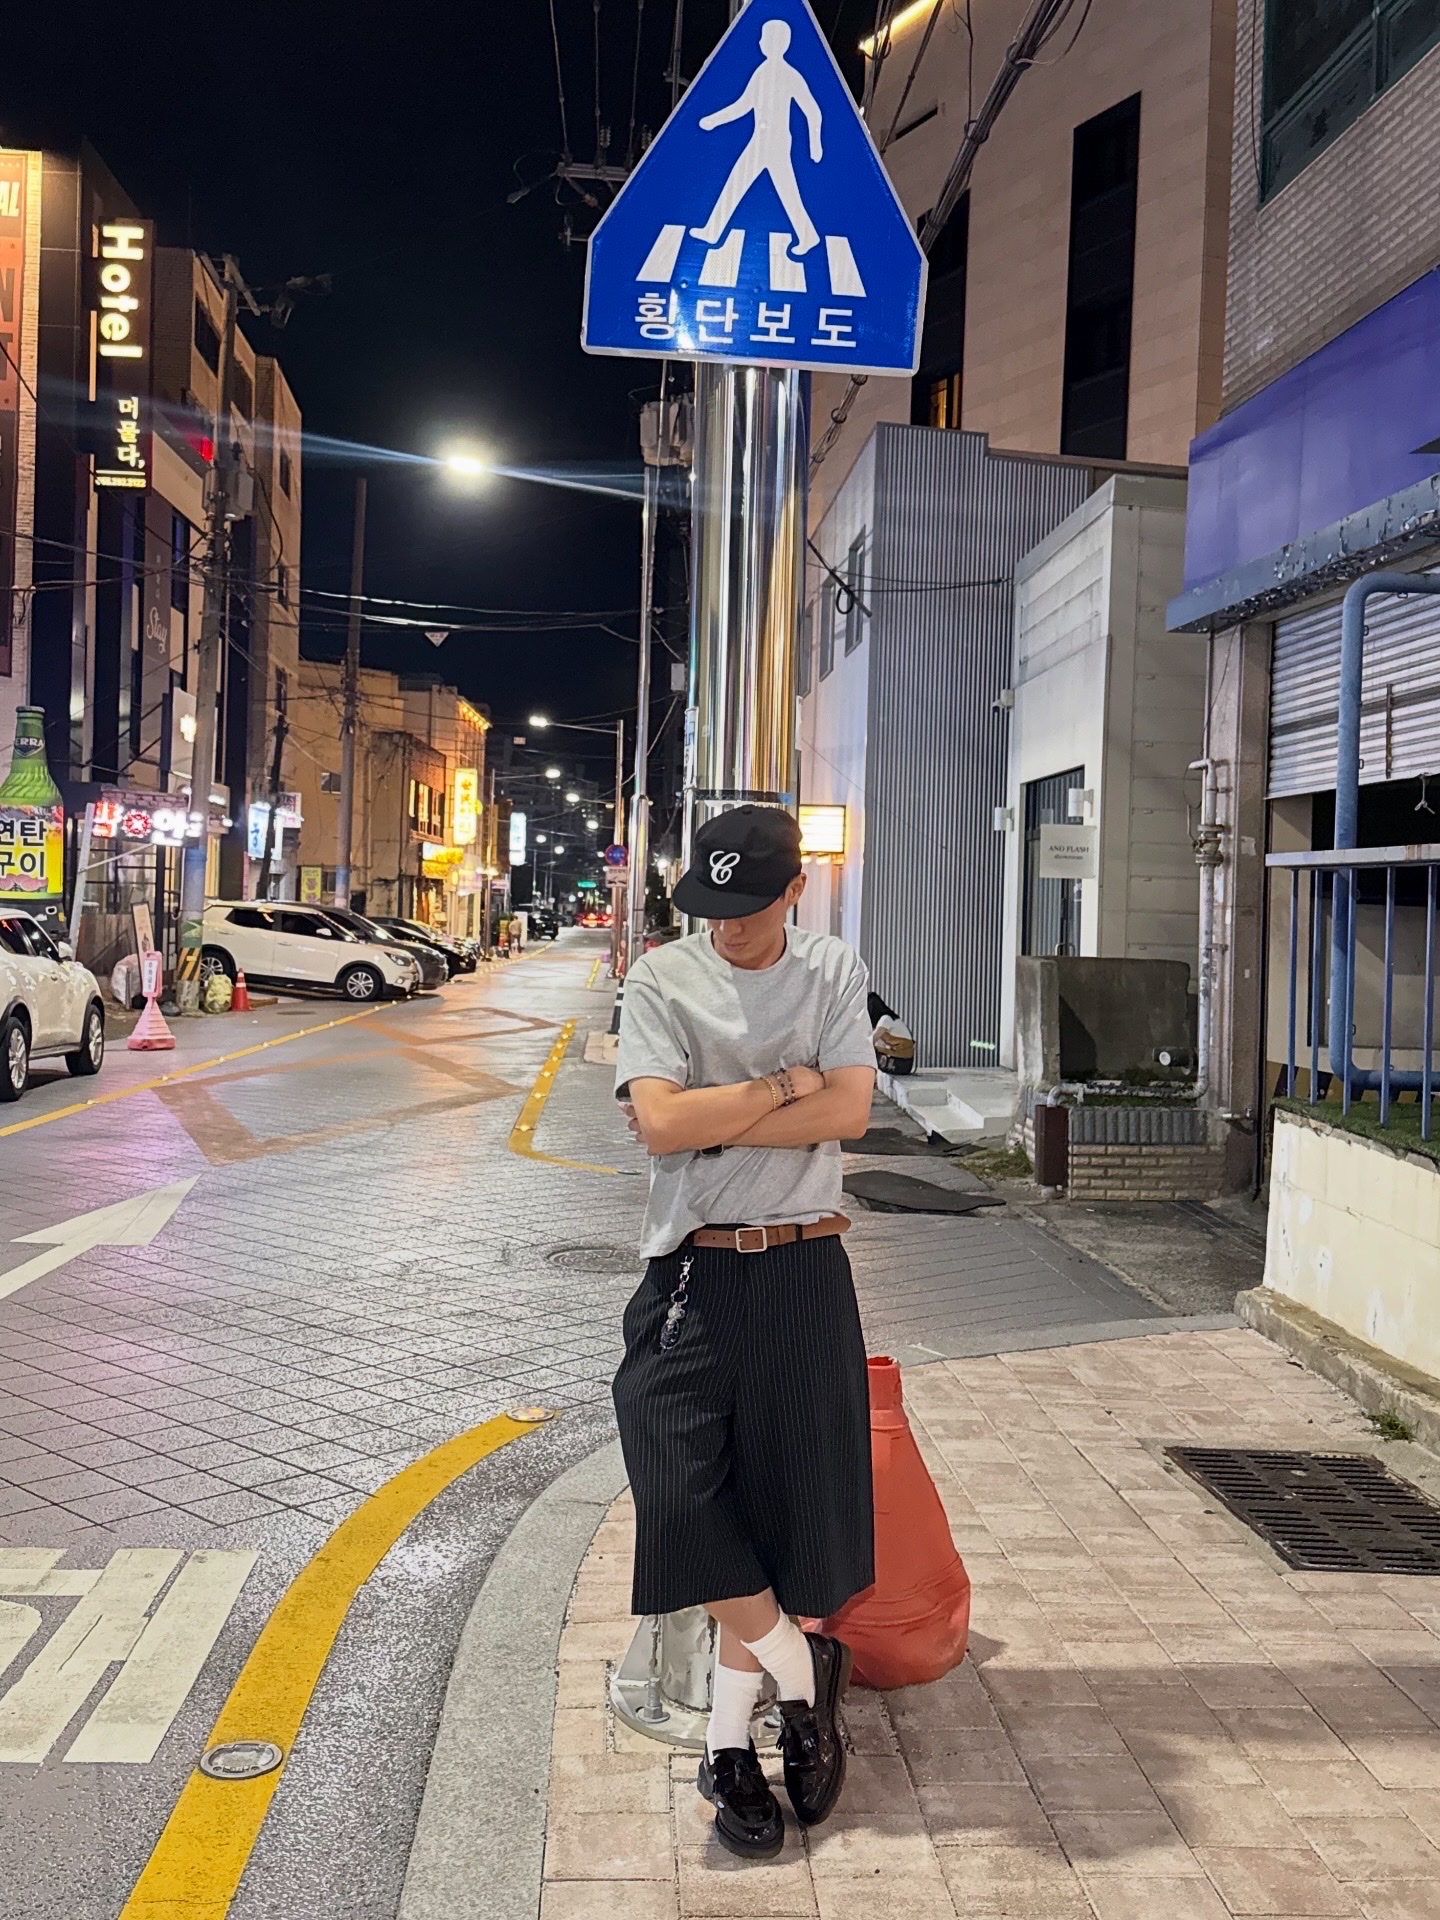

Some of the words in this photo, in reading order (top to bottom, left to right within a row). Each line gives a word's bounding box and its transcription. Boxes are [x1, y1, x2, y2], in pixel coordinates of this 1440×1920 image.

[100, 224, 145, 359] Hotel
[634, 292, 857, 348] 횡단보도
[146, 607, 168, 655] Stay
[709, 850, 741, 885] C
